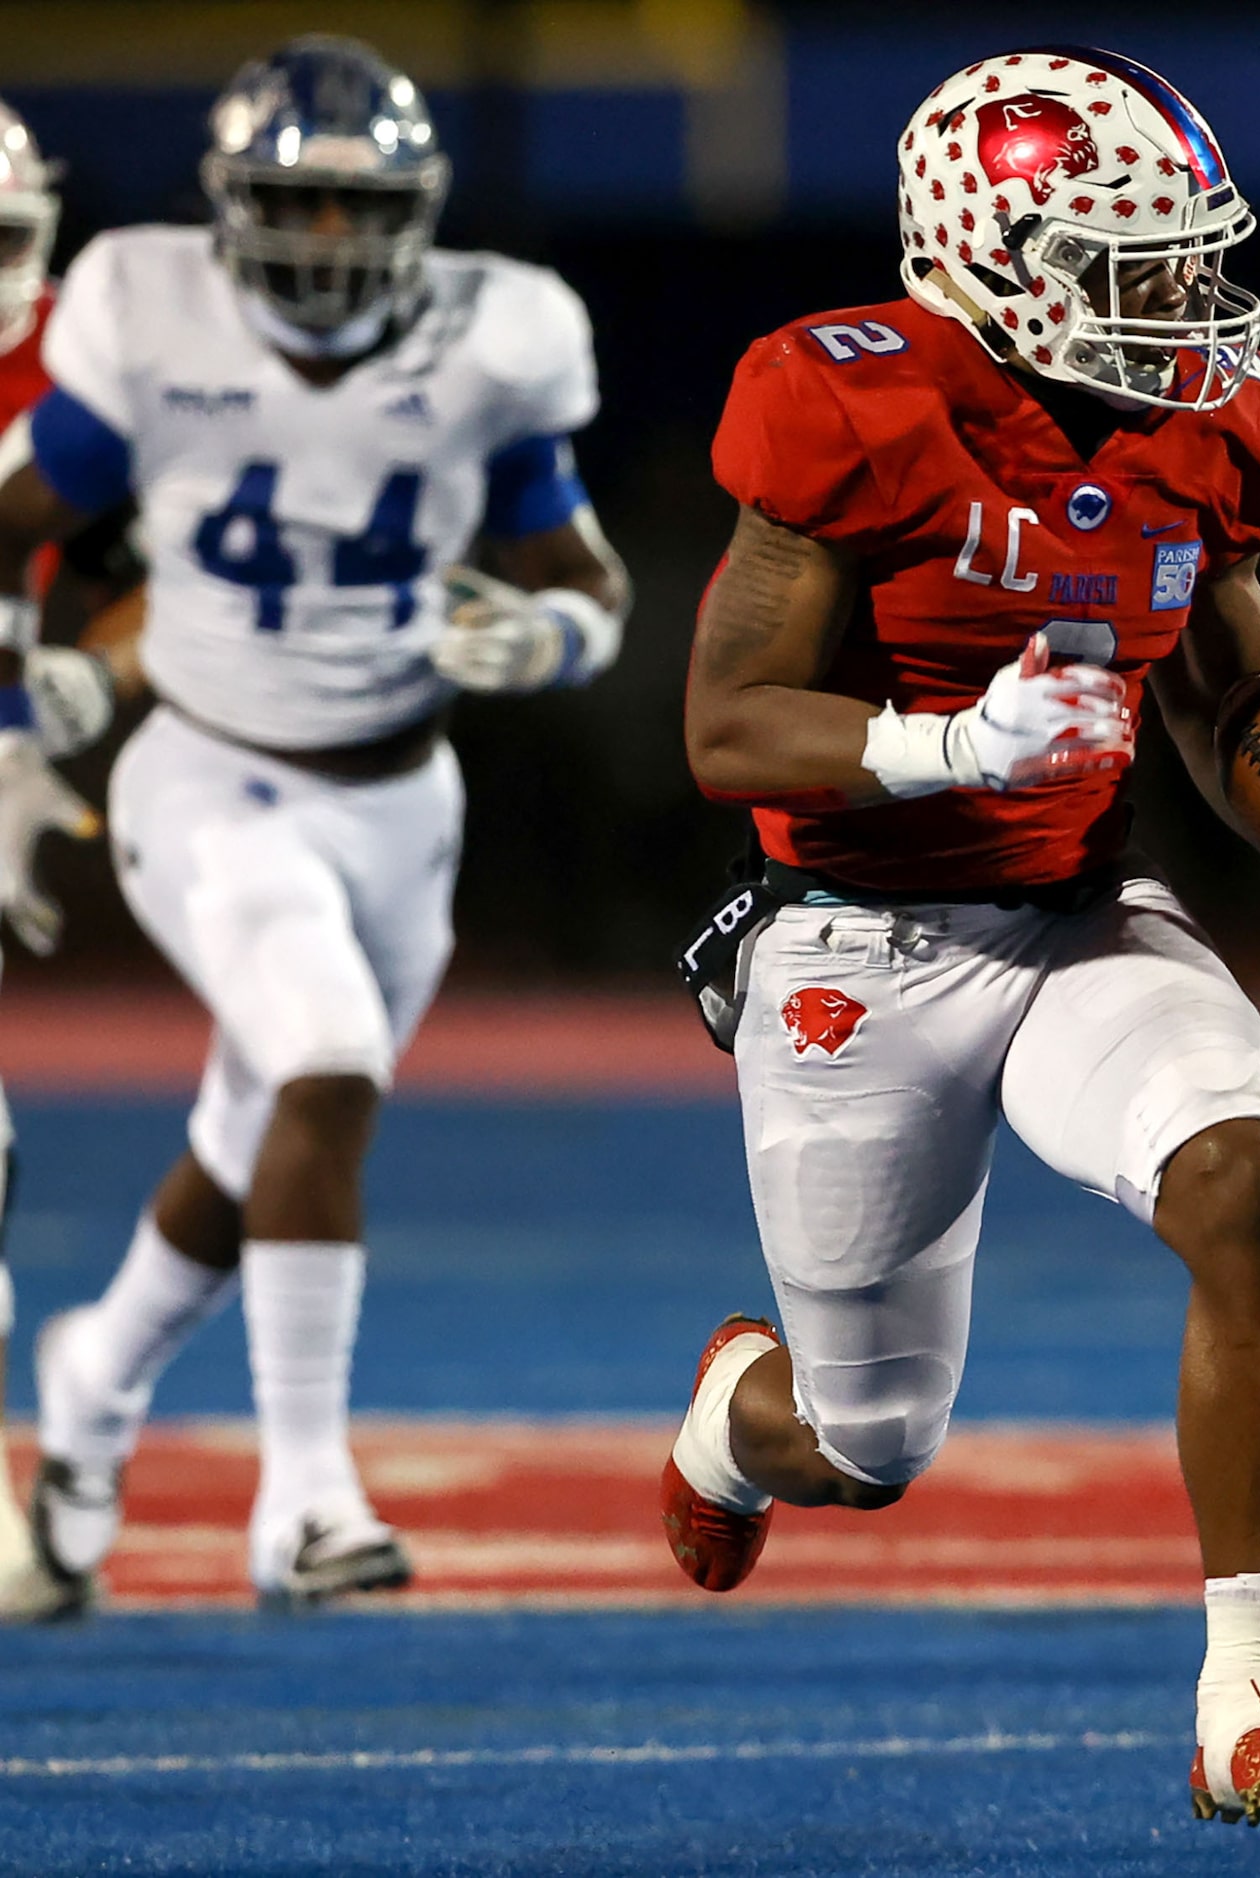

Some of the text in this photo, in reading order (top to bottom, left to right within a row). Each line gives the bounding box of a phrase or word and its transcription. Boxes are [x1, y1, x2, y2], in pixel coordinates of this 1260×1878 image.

[805, 320, 910, 364] 2
[190, 457, 430, 632] 44
[953, 501, 1040, 593] LC
[1152, 562, 1197, 605] 50
